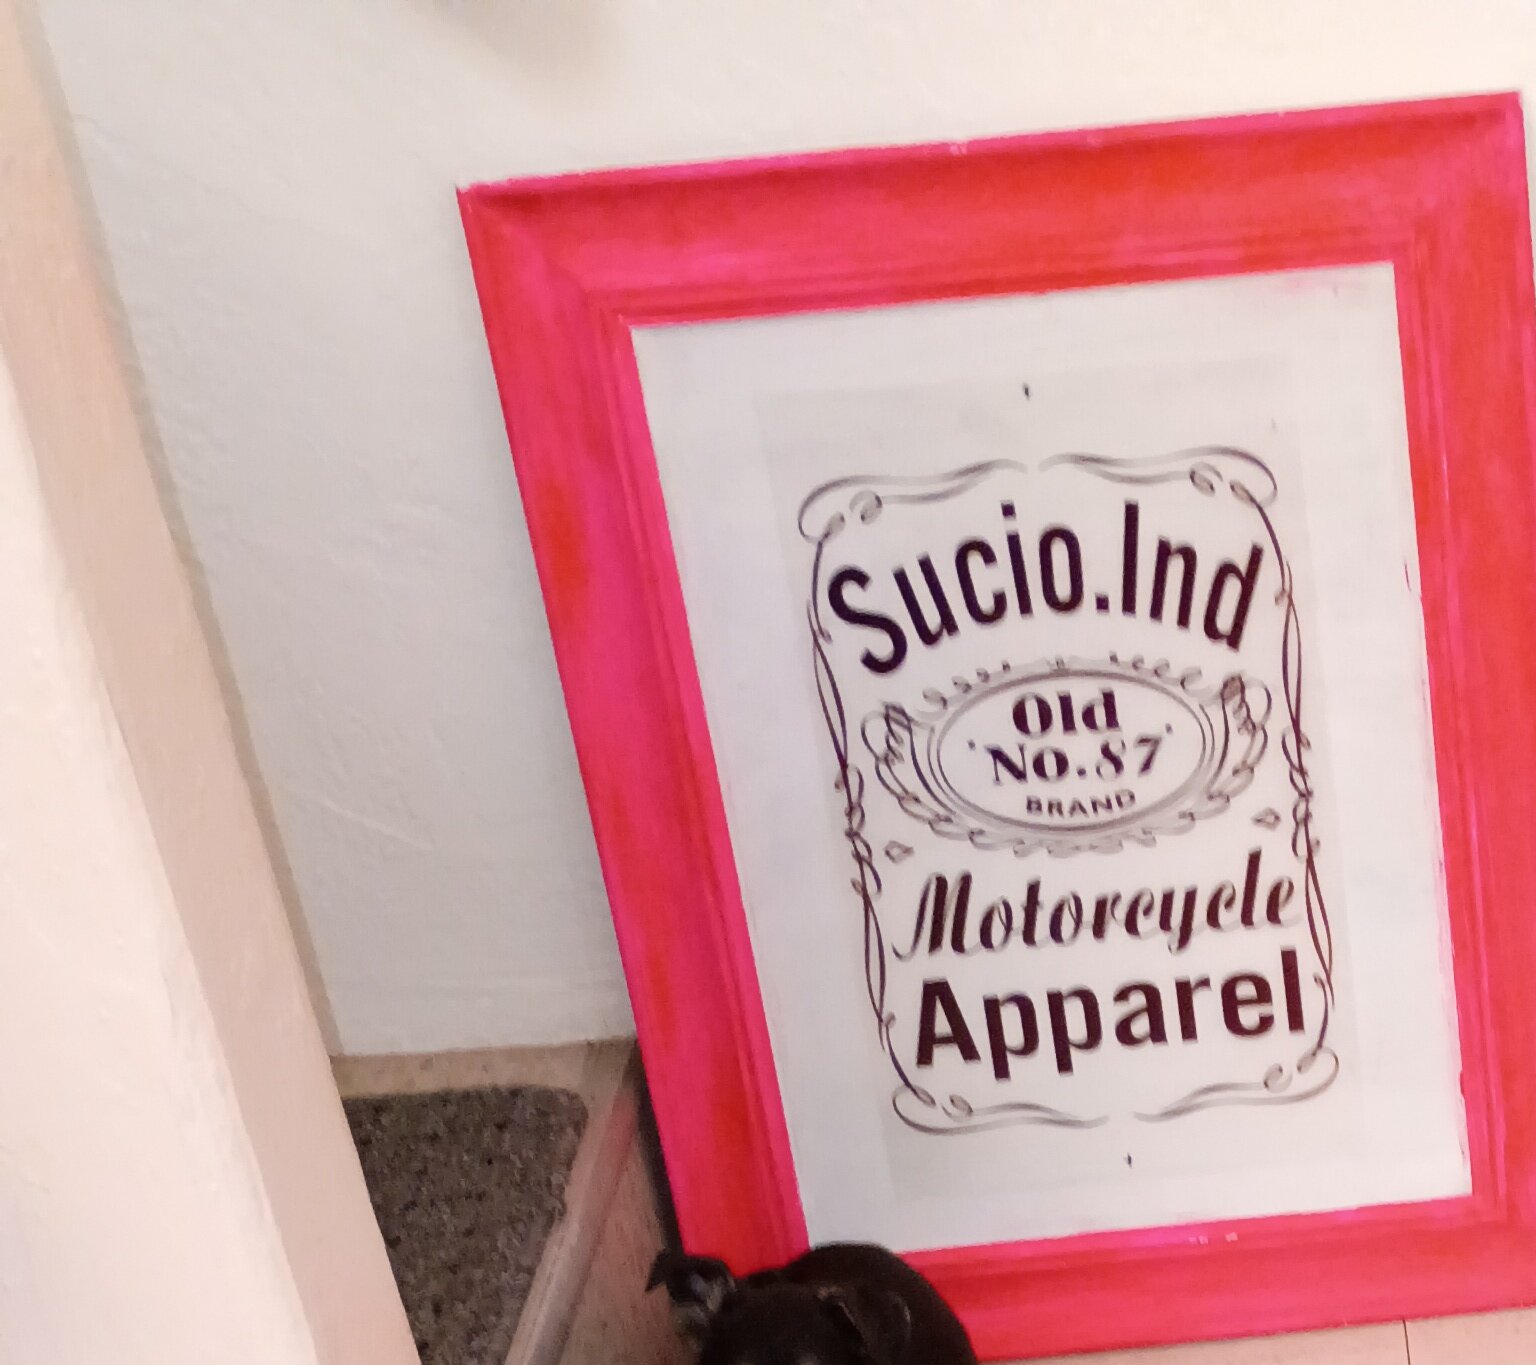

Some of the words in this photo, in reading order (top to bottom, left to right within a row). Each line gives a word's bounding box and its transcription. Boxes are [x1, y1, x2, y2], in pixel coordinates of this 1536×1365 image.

[828, 500, 1263, 674] Sucio.Ind
[1012, 688, 1121, 739] Old
[1026, 788, 1136, 818] BRAND
[893, 848, 1295, 961] Motorcycle
[916, 946, 1305, 1080] Apparel
